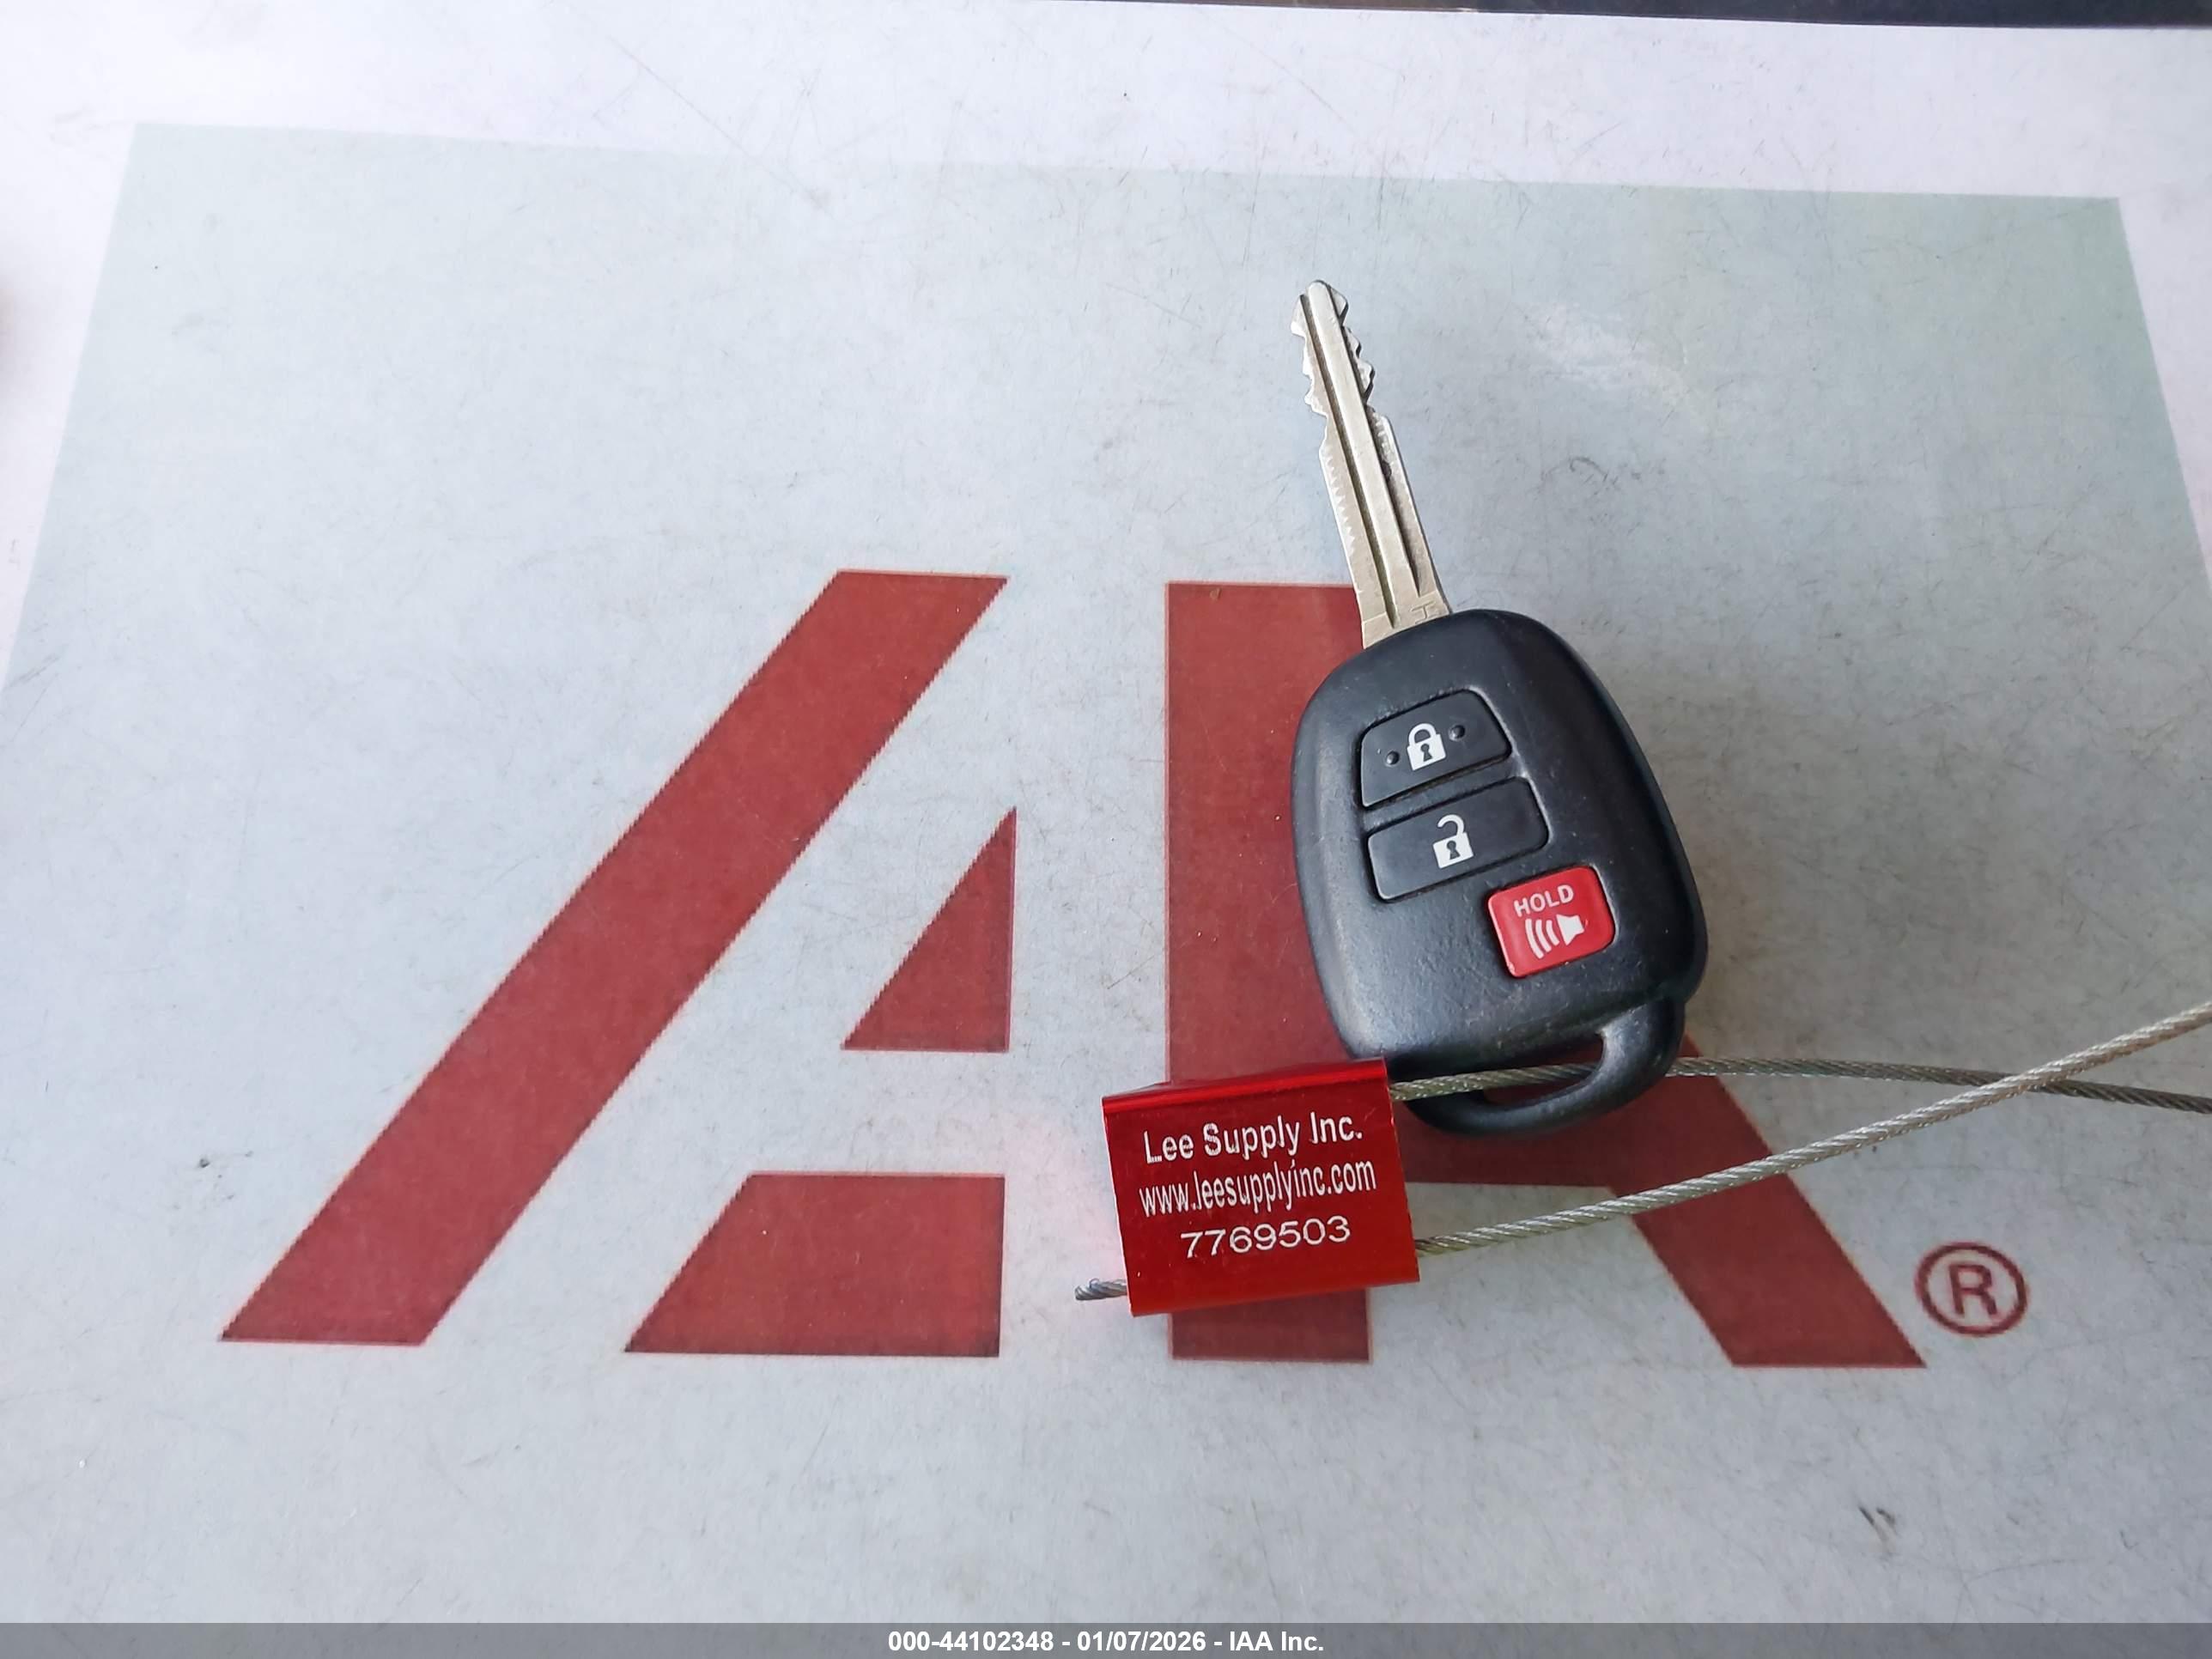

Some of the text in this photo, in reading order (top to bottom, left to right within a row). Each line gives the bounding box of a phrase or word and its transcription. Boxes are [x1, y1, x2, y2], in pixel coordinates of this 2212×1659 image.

[1513, 884, 1575, 918] HOLD
[1143, 1111, 1363, 1164] Lee Supply Inc.
[1139, 1158, 1377, 1218] www.leesupplyinc.com
[1180, 1215, 1351, 1259] 7769503
